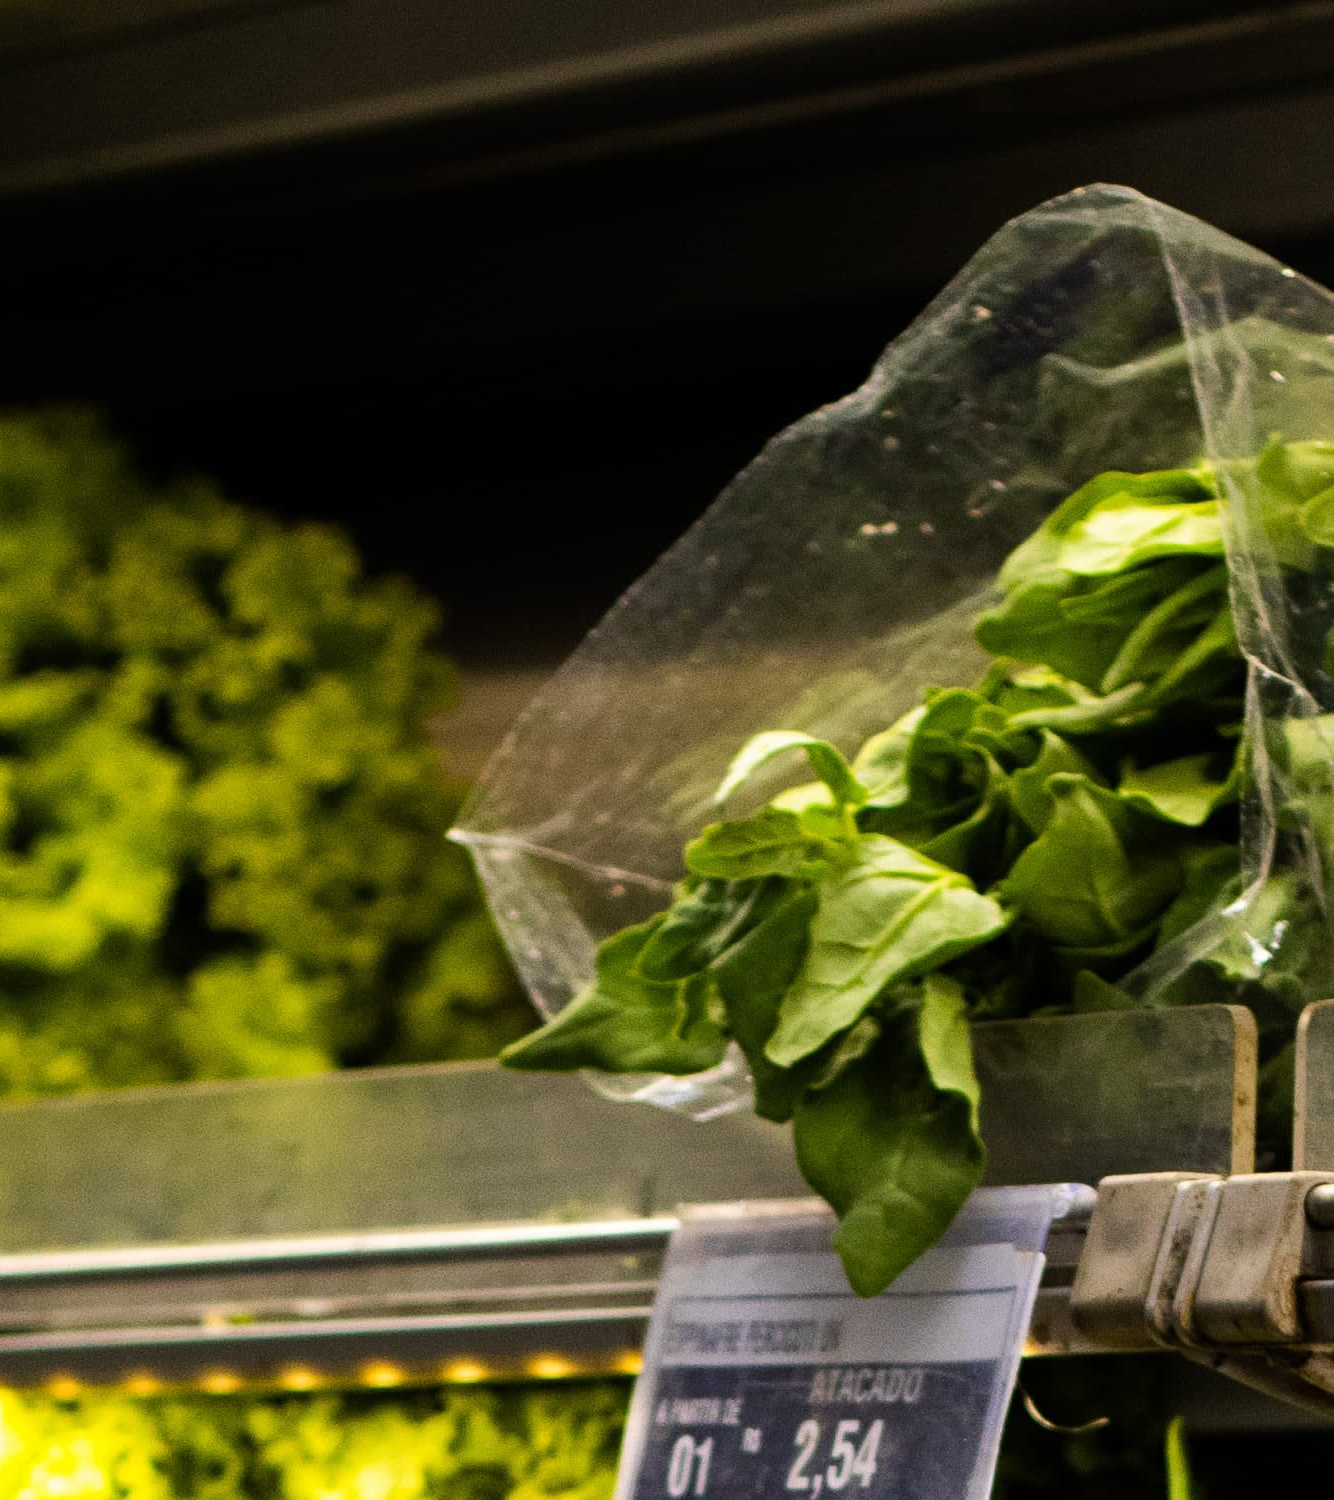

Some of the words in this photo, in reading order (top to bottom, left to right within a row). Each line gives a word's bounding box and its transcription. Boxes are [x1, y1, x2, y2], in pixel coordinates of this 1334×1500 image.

[809, 1369, 925, 1404] ATACADO
[667, 1435, 713, 1498] 01
[785, 1420, 885, 1500] 2,54
